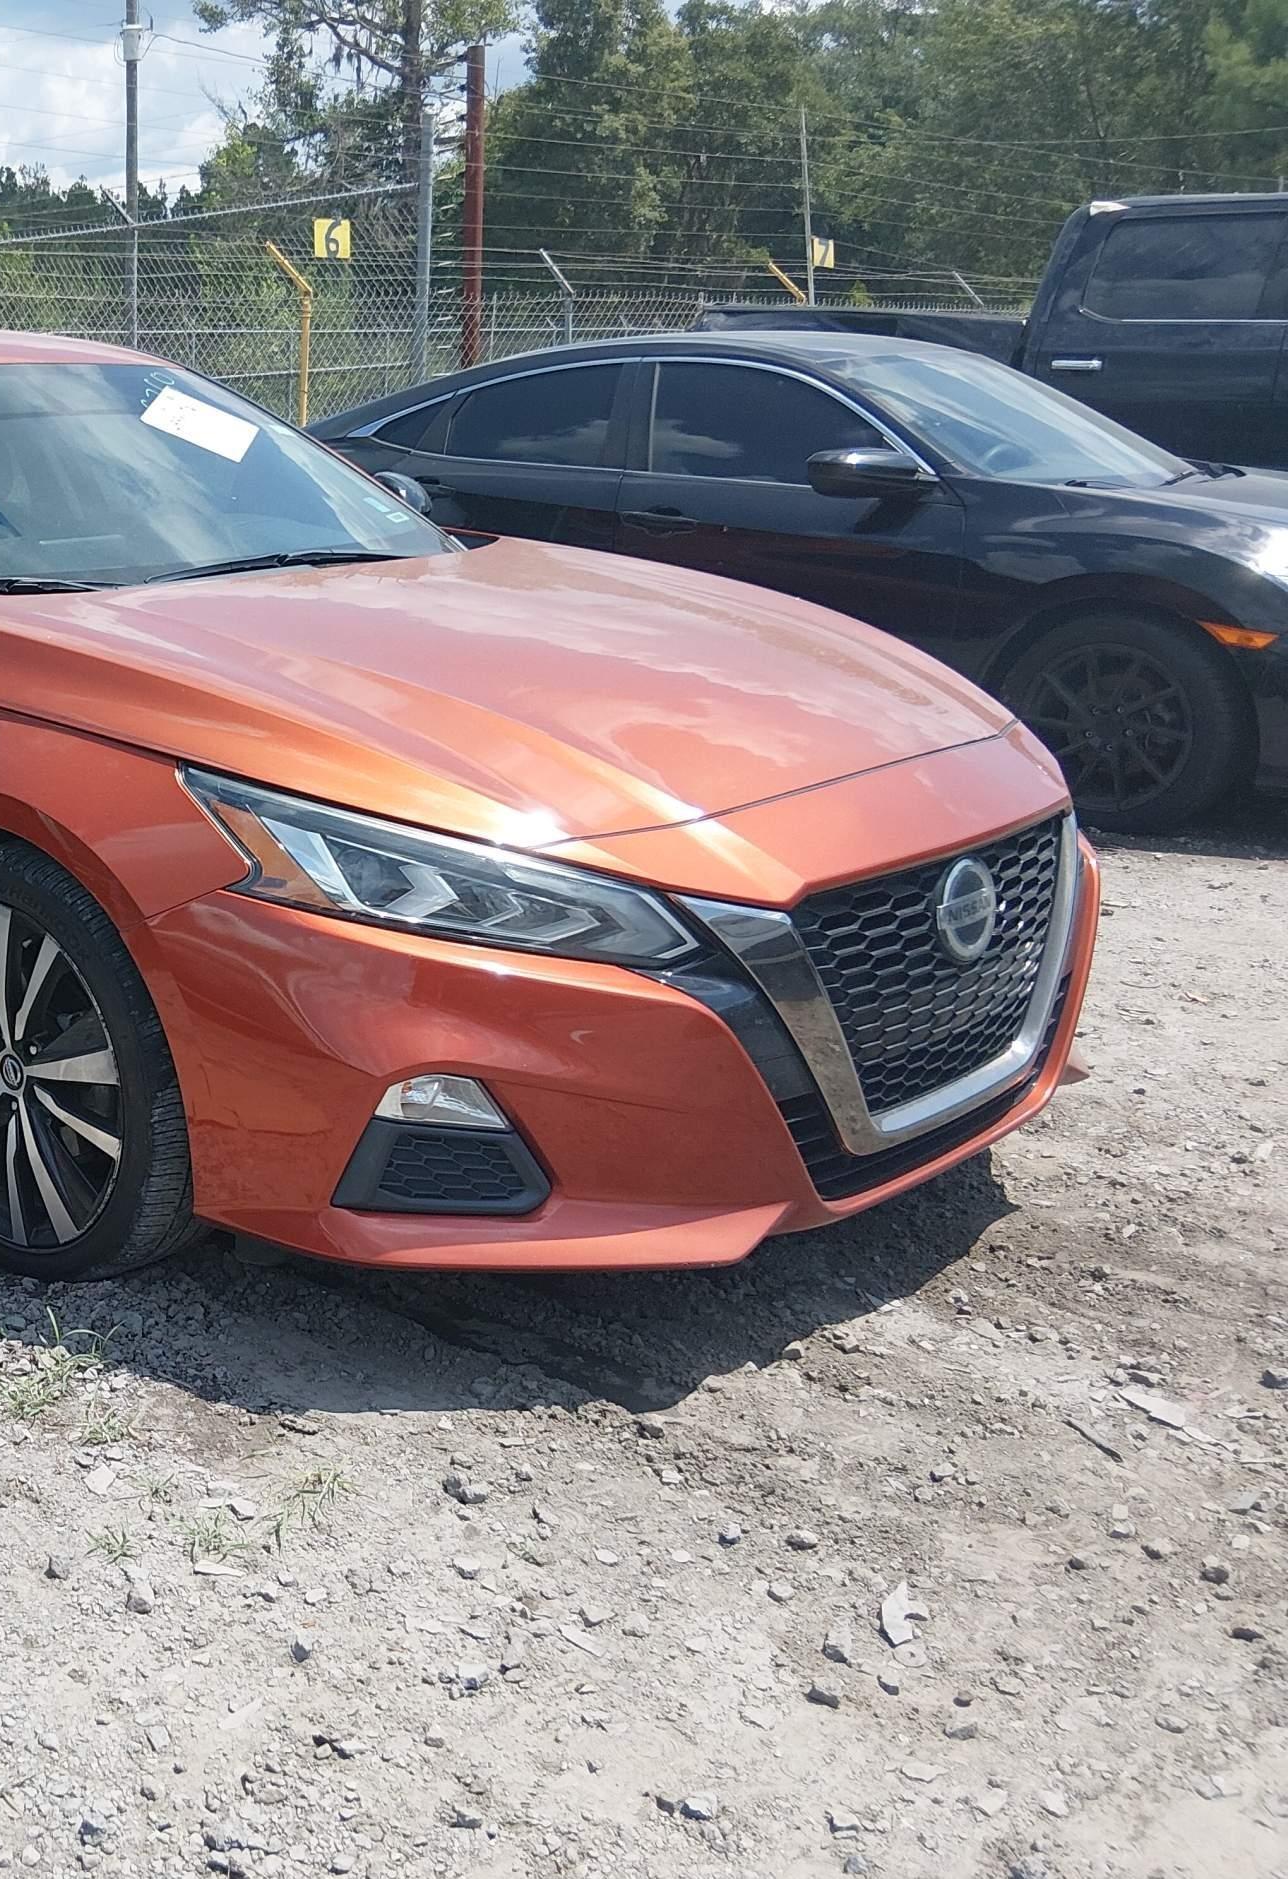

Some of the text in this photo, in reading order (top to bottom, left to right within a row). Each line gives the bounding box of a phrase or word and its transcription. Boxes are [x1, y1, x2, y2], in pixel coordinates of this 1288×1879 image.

[324, 219, 342, 258] 6
[818, 238, 830, 265] 7
[946, 895, 992, 926] NISSAN
